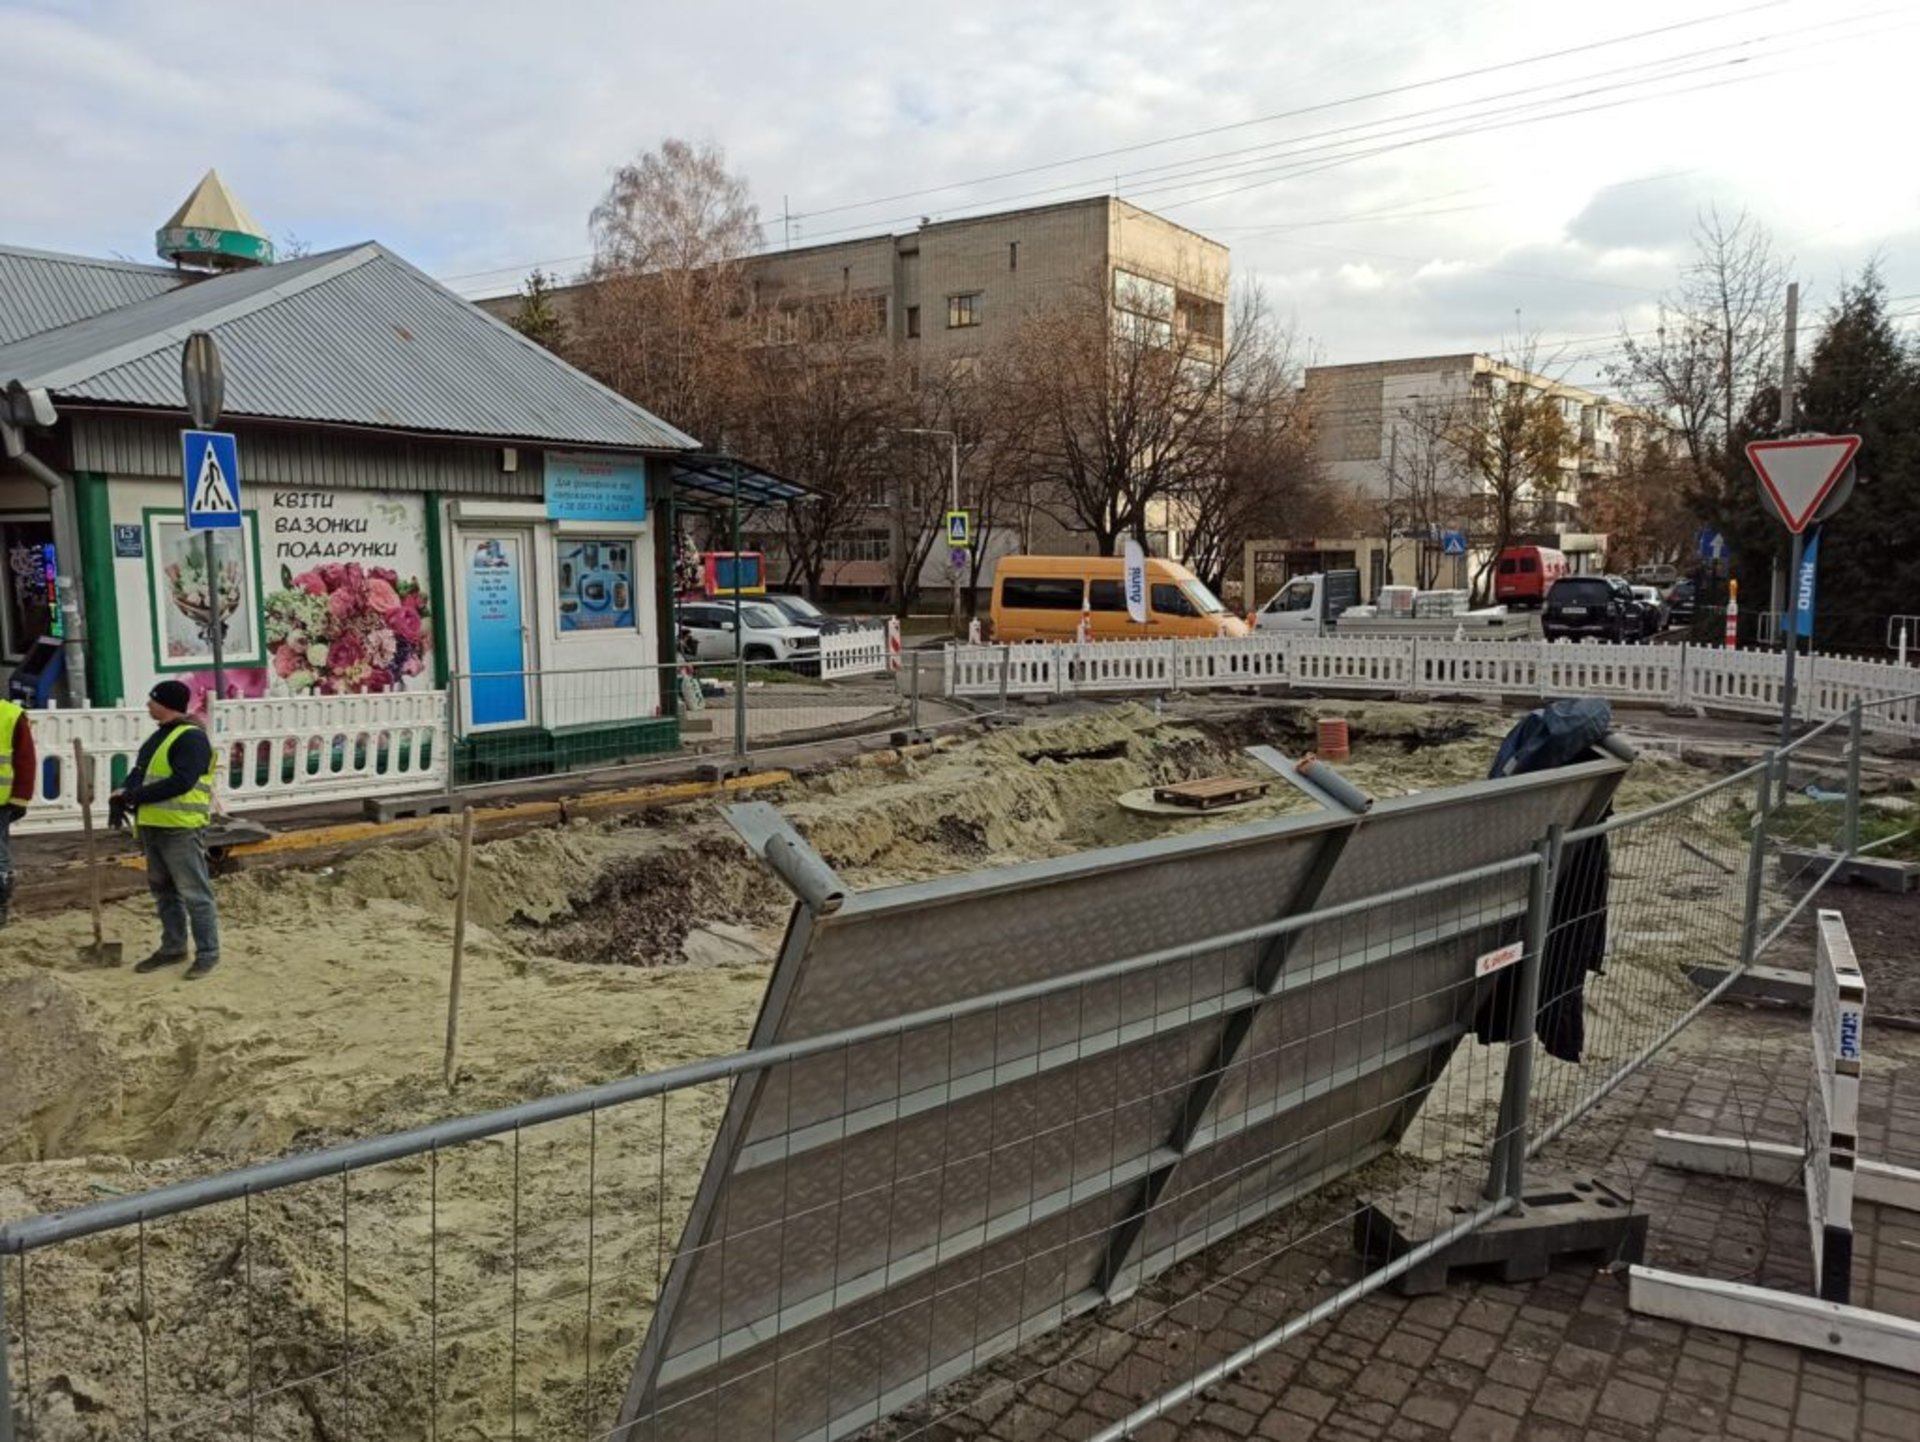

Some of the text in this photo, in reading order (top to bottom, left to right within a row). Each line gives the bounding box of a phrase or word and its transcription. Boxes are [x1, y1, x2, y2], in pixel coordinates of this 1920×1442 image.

[273, 492, 334, 508] КВІТИ
[275, 517, 368, 533] ВАЗОНКИ
[277, 541, 397, 558] ПОДАРУНКИ
